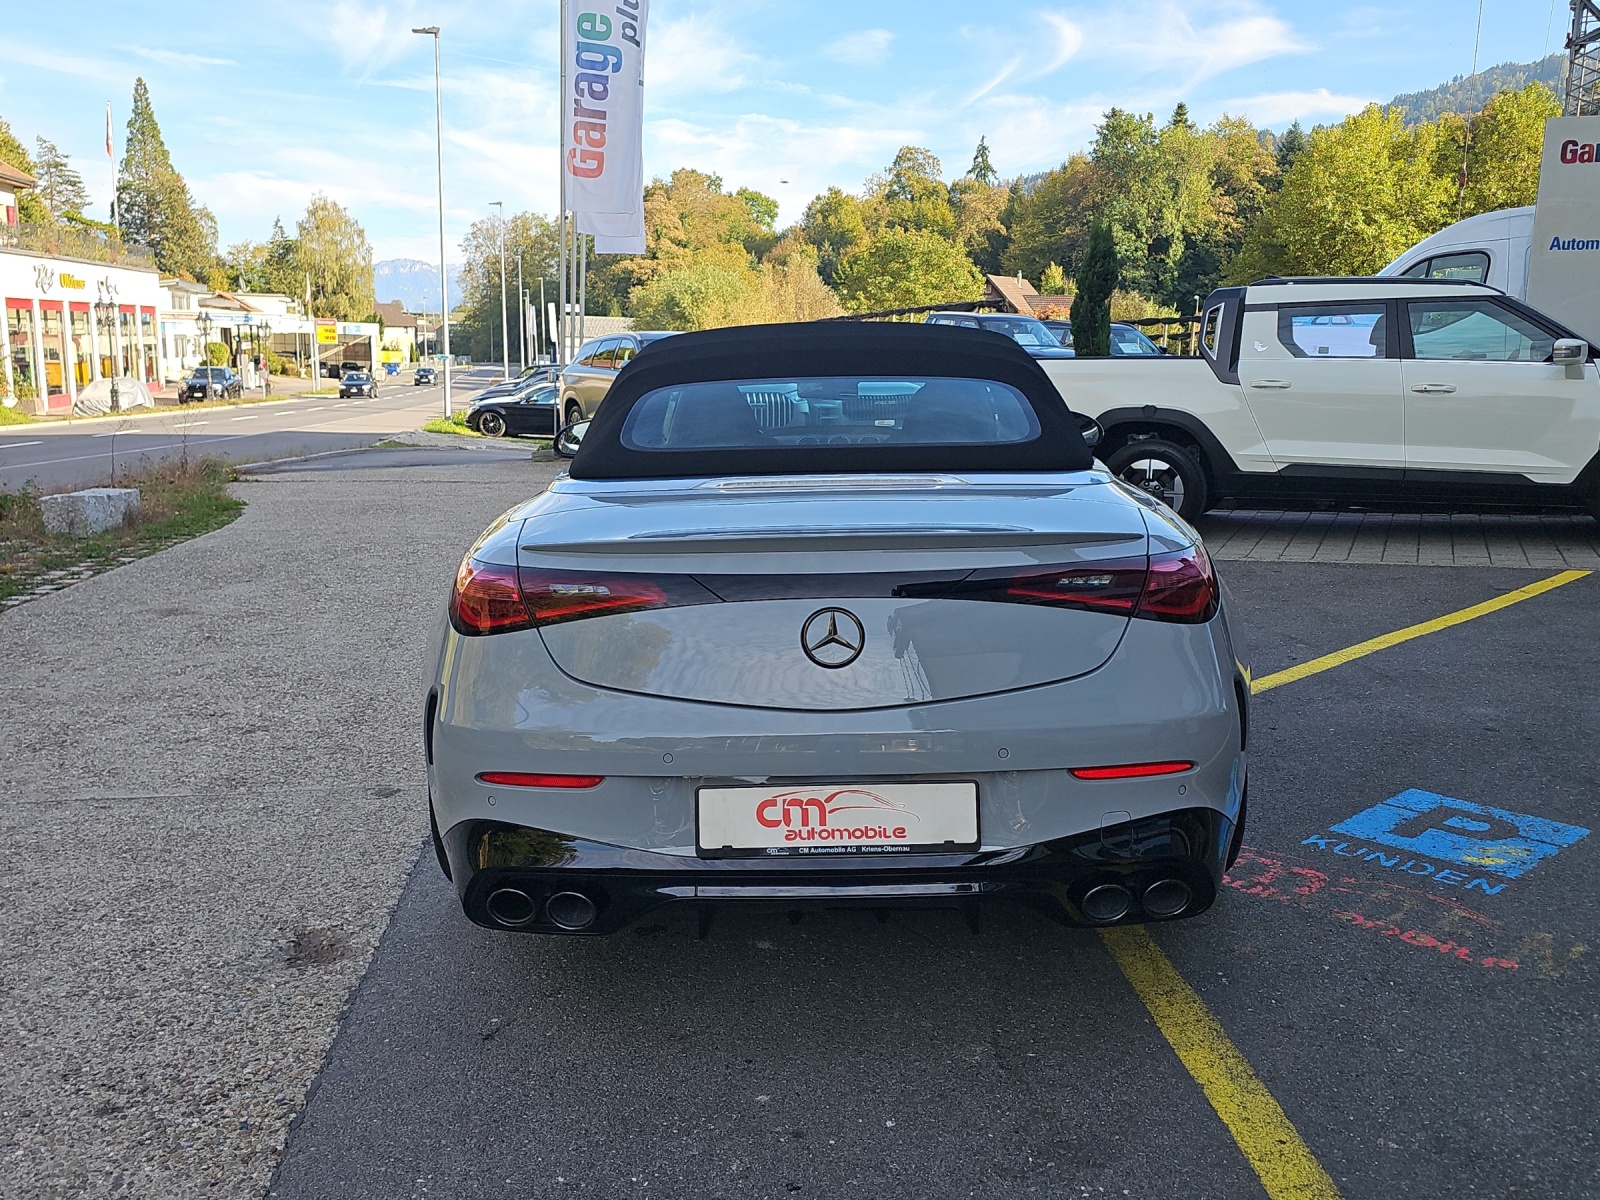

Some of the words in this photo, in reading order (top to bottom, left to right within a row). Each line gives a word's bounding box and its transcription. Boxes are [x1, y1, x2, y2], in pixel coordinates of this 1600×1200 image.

[566, 12, 623, 179] Garage
[756, 797, 828, 828] cm
[784, 825, 908, 842] automobile
[810, 846, 846, 854] Automobile
[861, 845, 910, 853] Kriens-Obernau
[1301, 834, 1509, 896] KUNDEN
